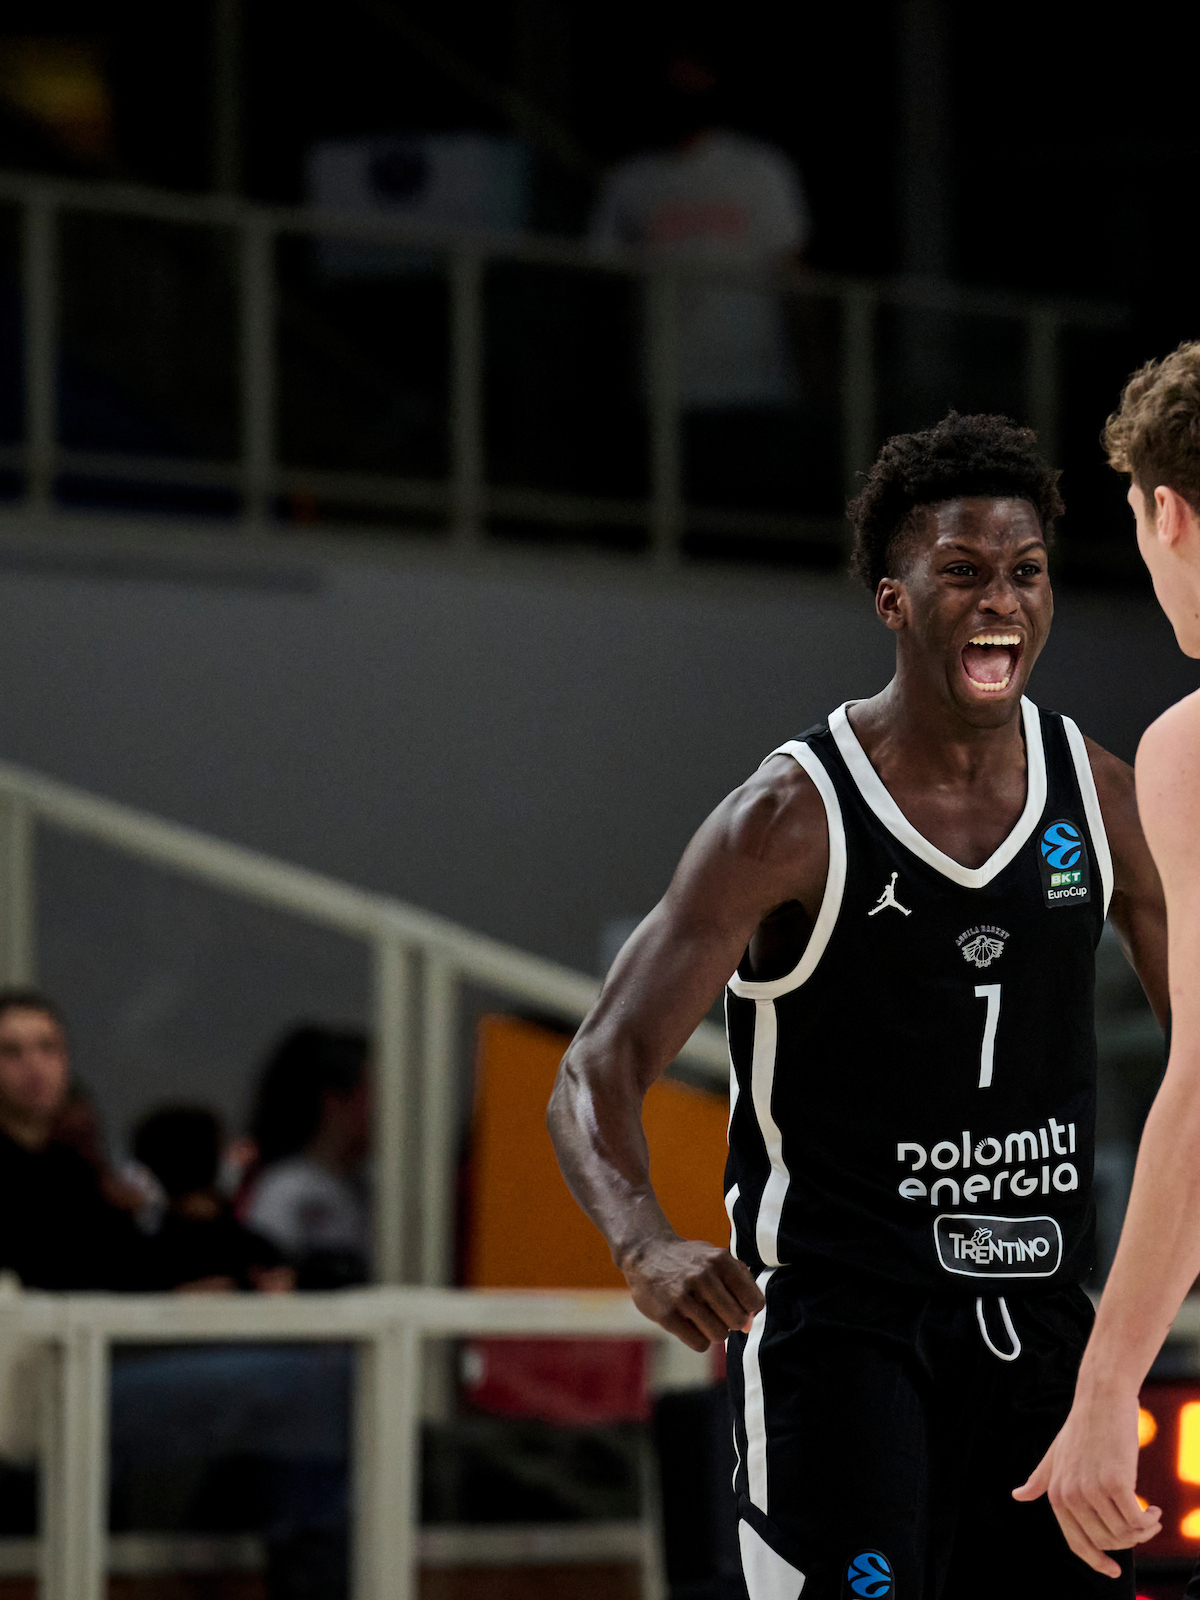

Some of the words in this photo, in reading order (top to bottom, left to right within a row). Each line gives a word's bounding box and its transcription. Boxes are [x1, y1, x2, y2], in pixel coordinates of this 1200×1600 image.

[1051, 871, 1081, 886] BKT
[1047, 886, 1087, 900] EuroCup
[948, 1232, 1050, 1265] TRENTINO
